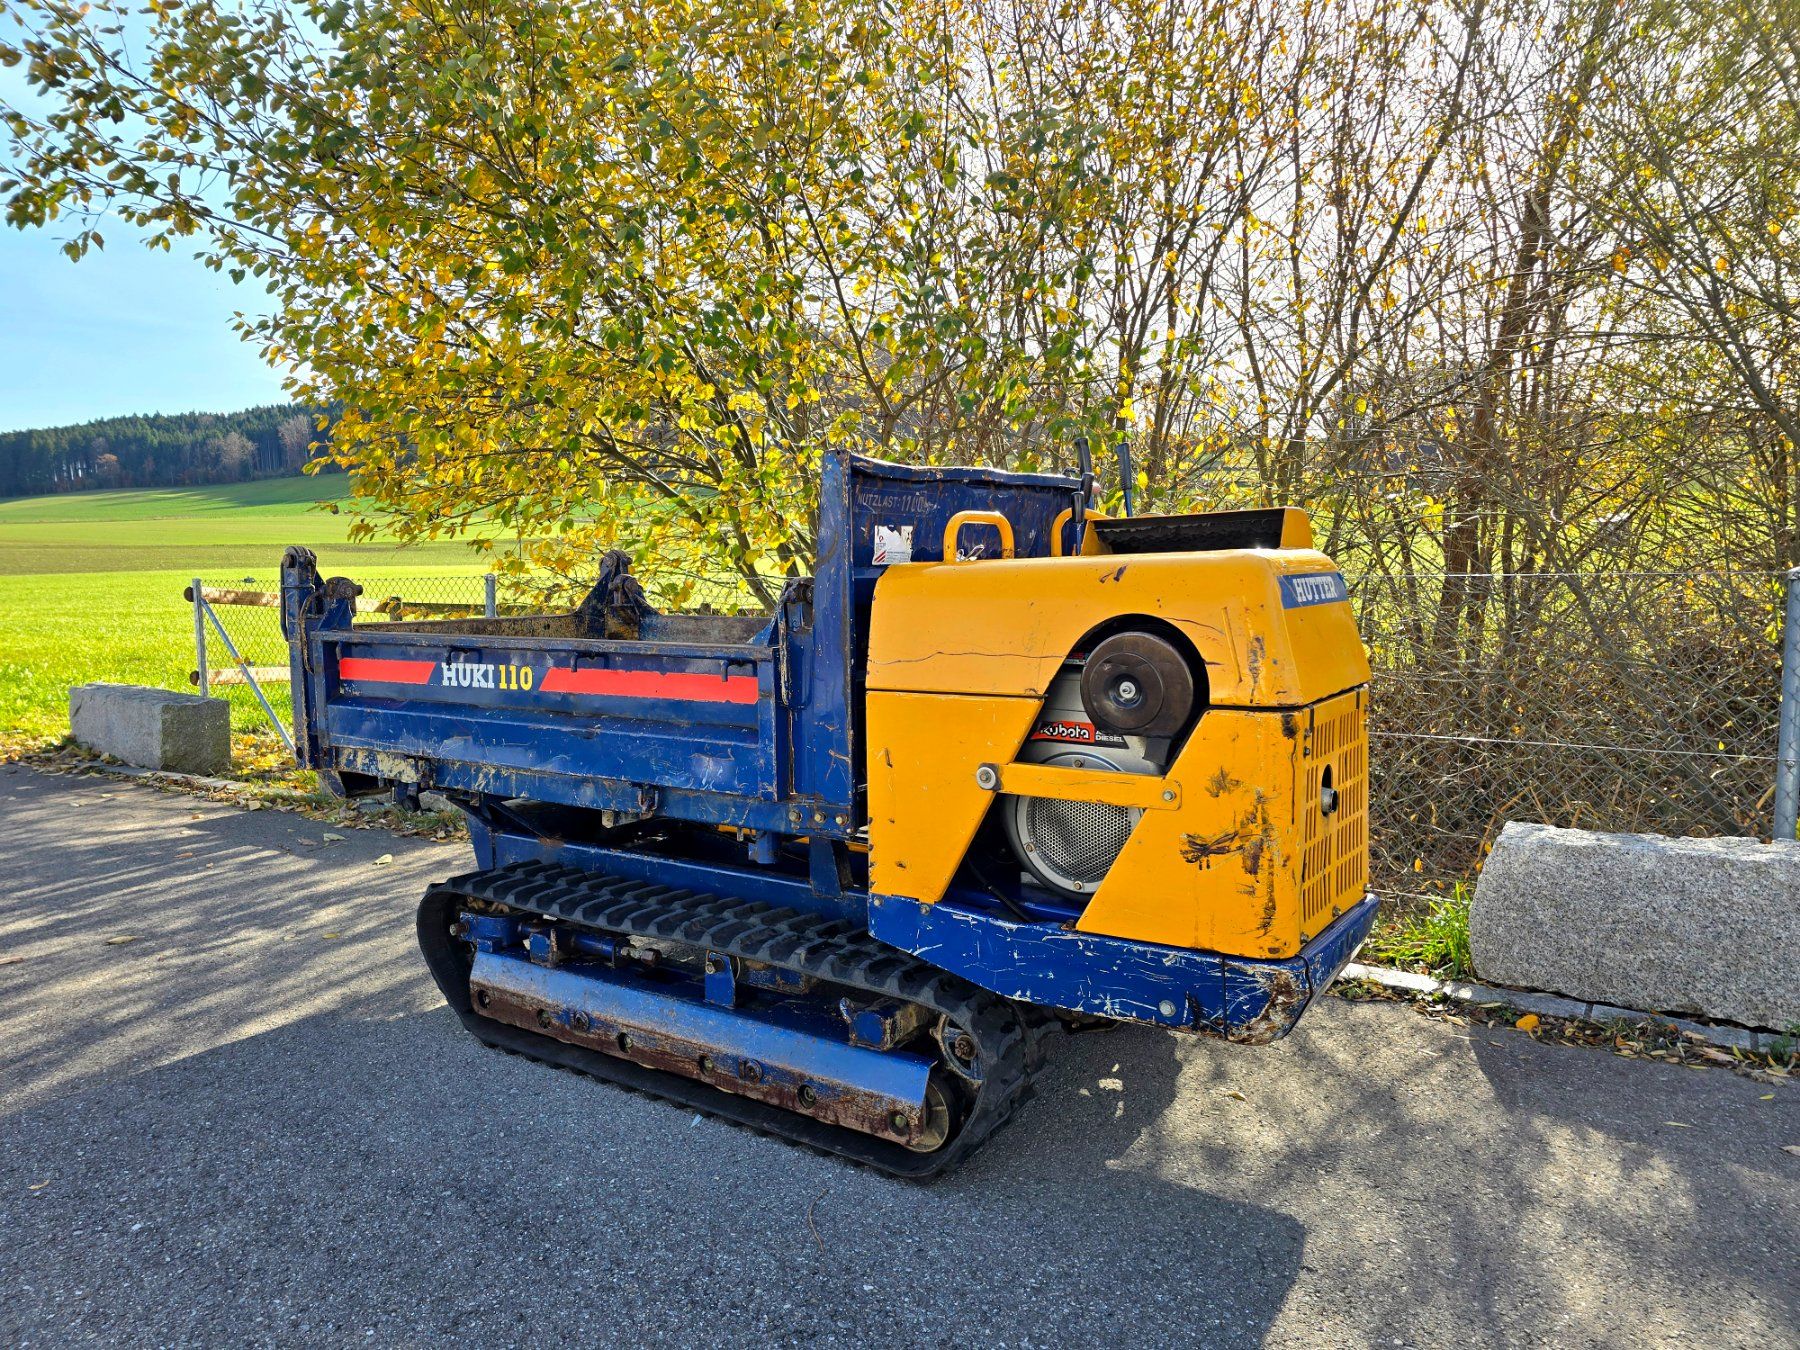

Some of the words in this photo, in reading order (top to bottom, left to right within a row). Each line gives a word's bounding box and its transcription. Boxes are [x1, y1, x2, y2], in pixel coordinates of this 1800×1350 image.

[1293, 576, 1337, 602] HUTTER
[441, 662, 494, 688] HUKI
[499, 664, 533, 691] 110
[1041, 724, 1089, 739] Kubota
[1095, 734, 1125, 743] DIESEL
